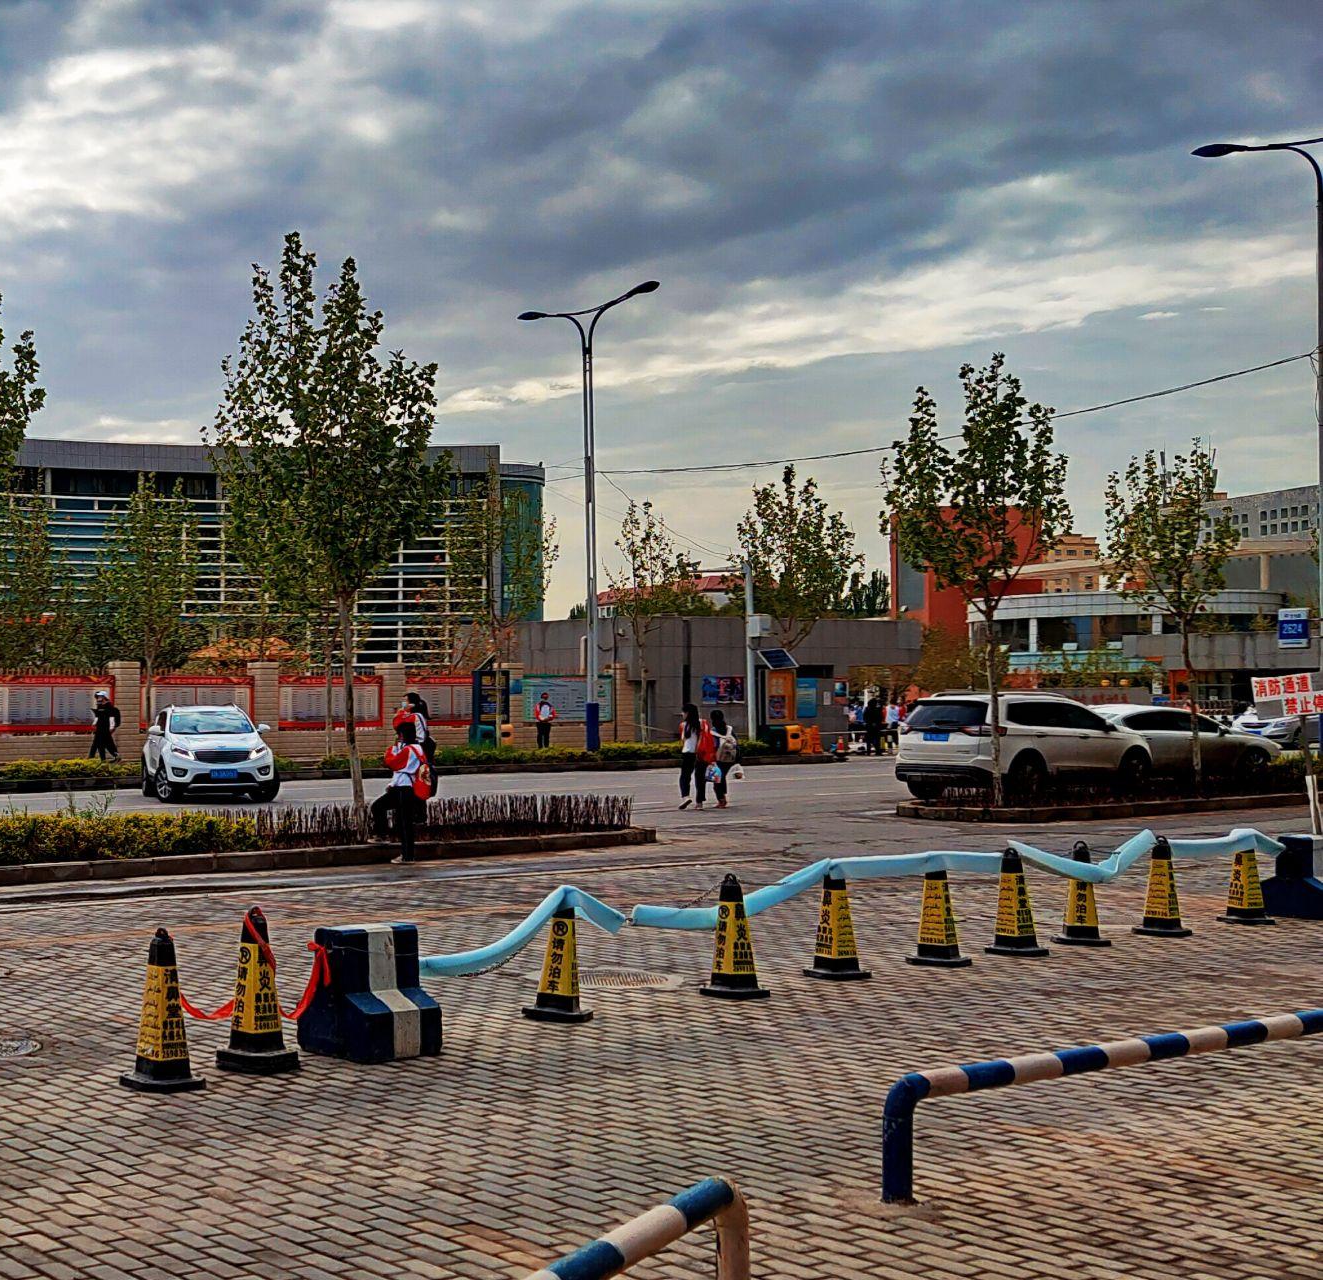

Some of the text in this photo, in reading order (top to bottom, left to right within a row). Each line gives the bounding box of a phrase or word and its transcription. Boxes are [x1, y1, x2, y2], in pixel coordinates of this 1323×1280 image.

[1254, 675, 1309, 697] 消防通道
[547, 937, 565, 992] 请勿泊车
[232, 966, 248, 1029] 请勿泊车
